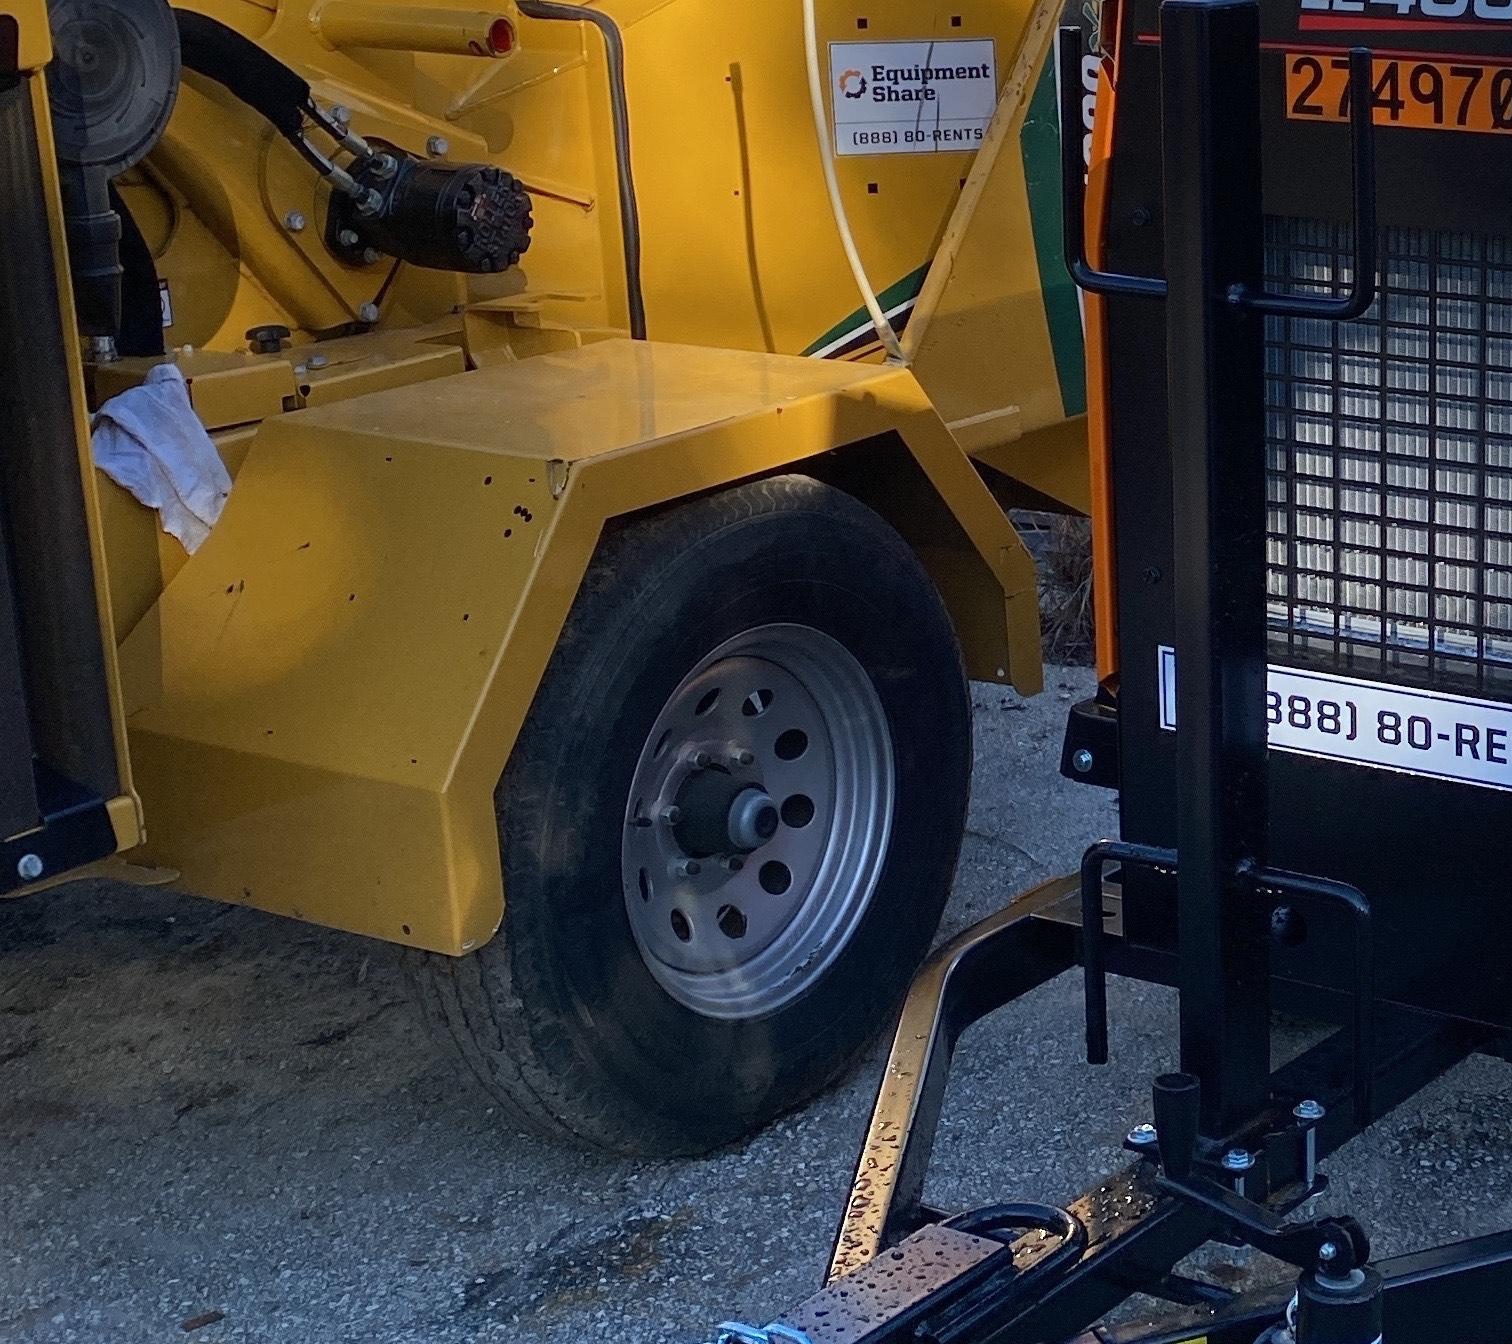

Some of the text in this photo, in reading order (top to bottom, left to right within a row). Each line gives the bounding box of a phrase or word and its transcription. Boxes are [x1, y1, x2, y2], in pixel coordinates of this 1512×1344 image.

[871, 63, 990, 85] Equipment
[872, 86, 936, 103] Share
[853, 128, 983, 145] (888) 80-RENTS
[1266, 690, 1357, 741] 888)
